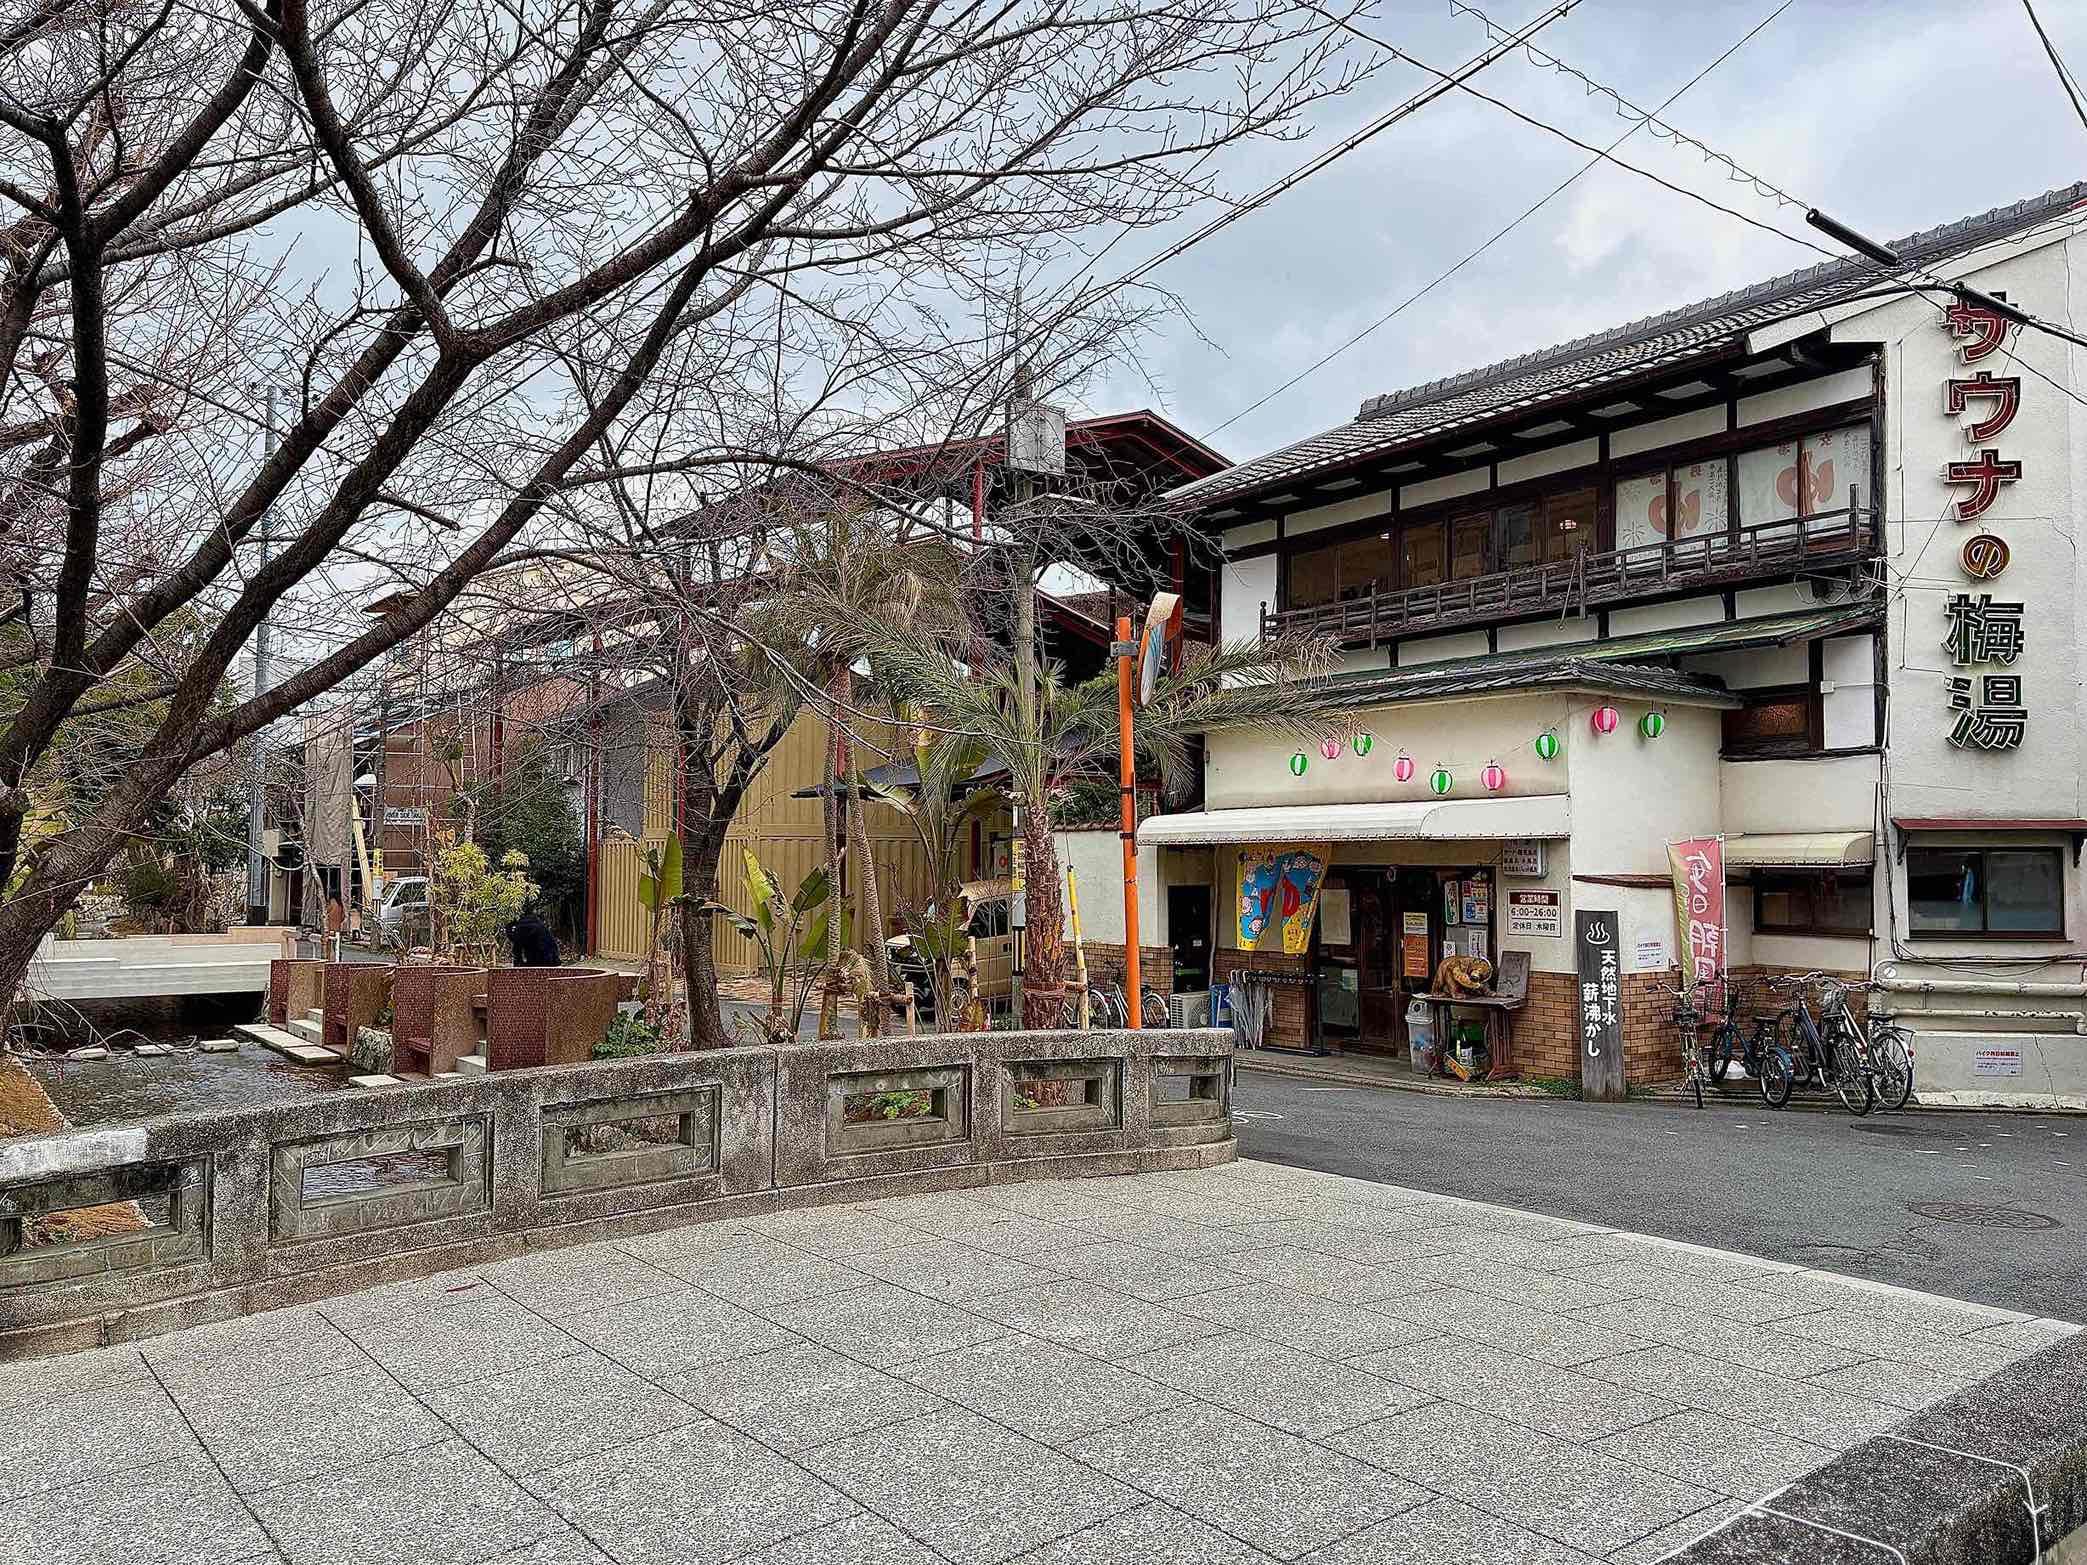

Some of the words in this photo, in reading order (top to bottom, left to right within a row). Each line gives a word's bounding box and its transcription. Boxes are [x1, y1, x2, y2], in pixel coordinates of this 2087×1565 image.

[1943, 291, 2028, 748] サウナの梅湯
[1582, 982, 1602, 1057] 薪沸かし
[1600, 949, 1617, 1026] 天然地下水
